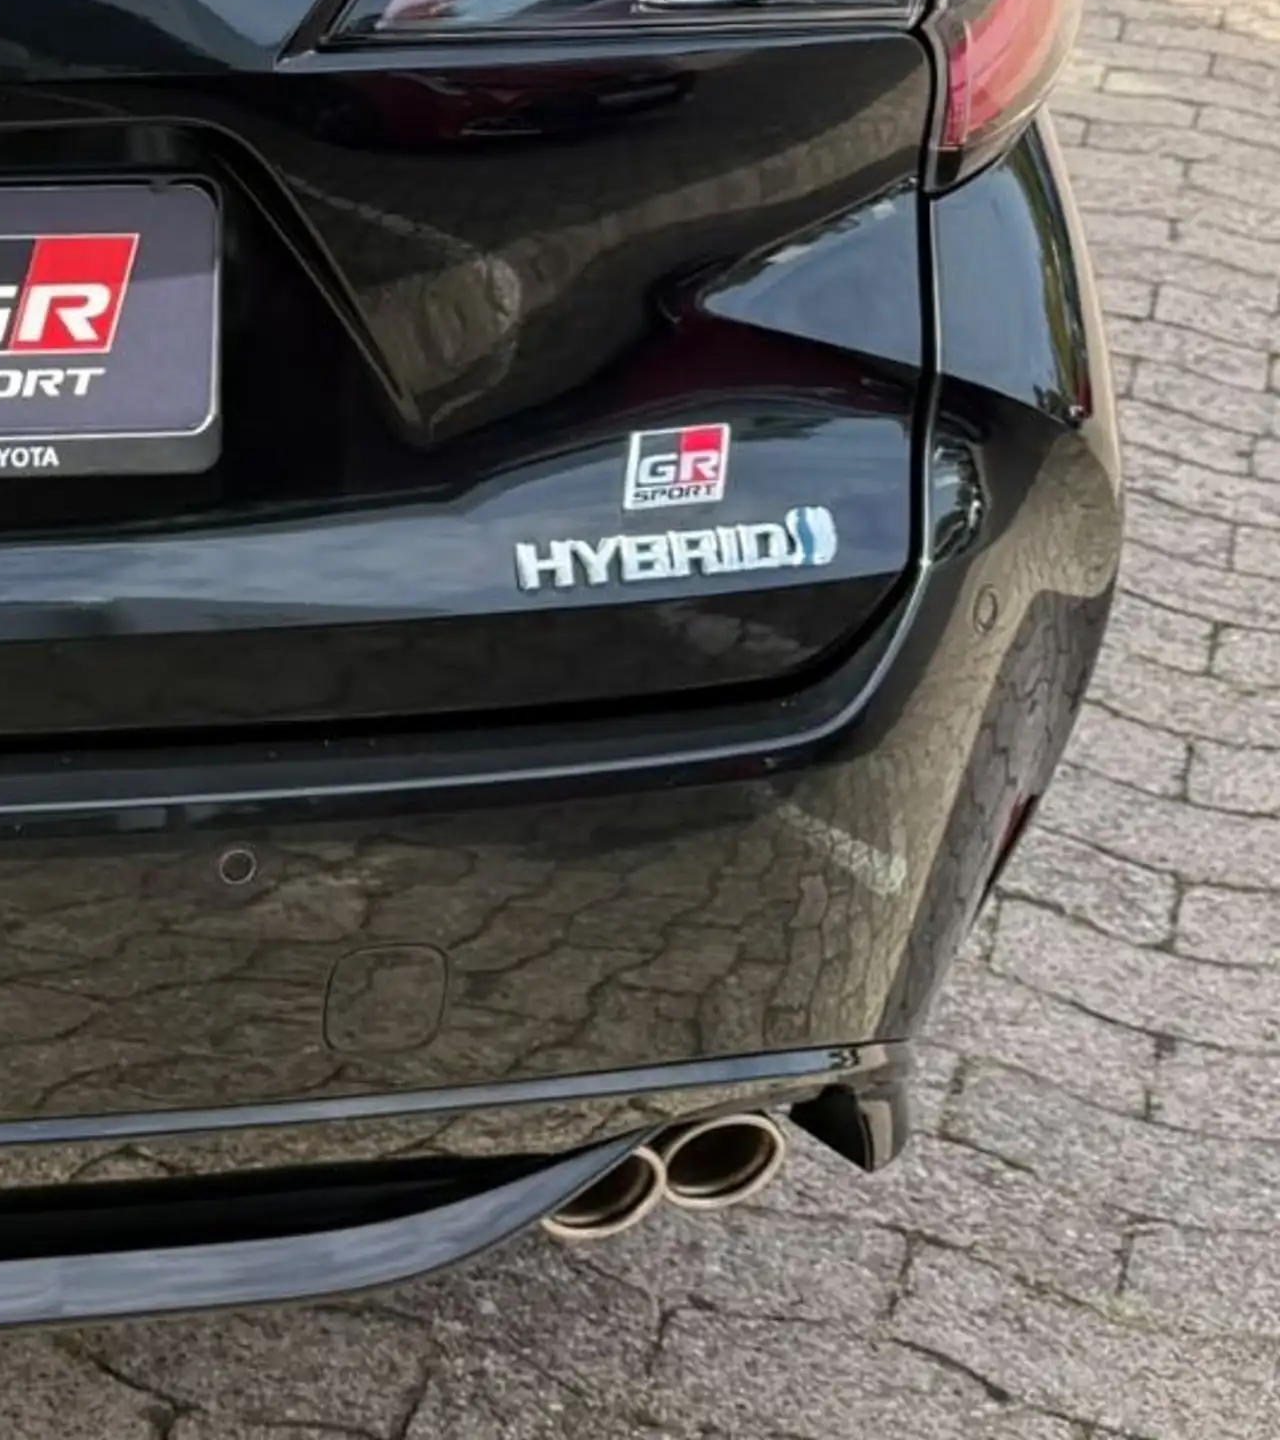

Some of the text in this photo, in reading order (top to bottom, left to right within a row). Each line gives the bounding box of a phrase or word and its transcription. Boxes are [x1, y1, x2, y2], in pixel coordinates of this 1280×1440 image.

[639, 450, 719, 482] GR
[633, 483, 718, 502] SPORT
[515, 523, 789, 590] HYBRID
